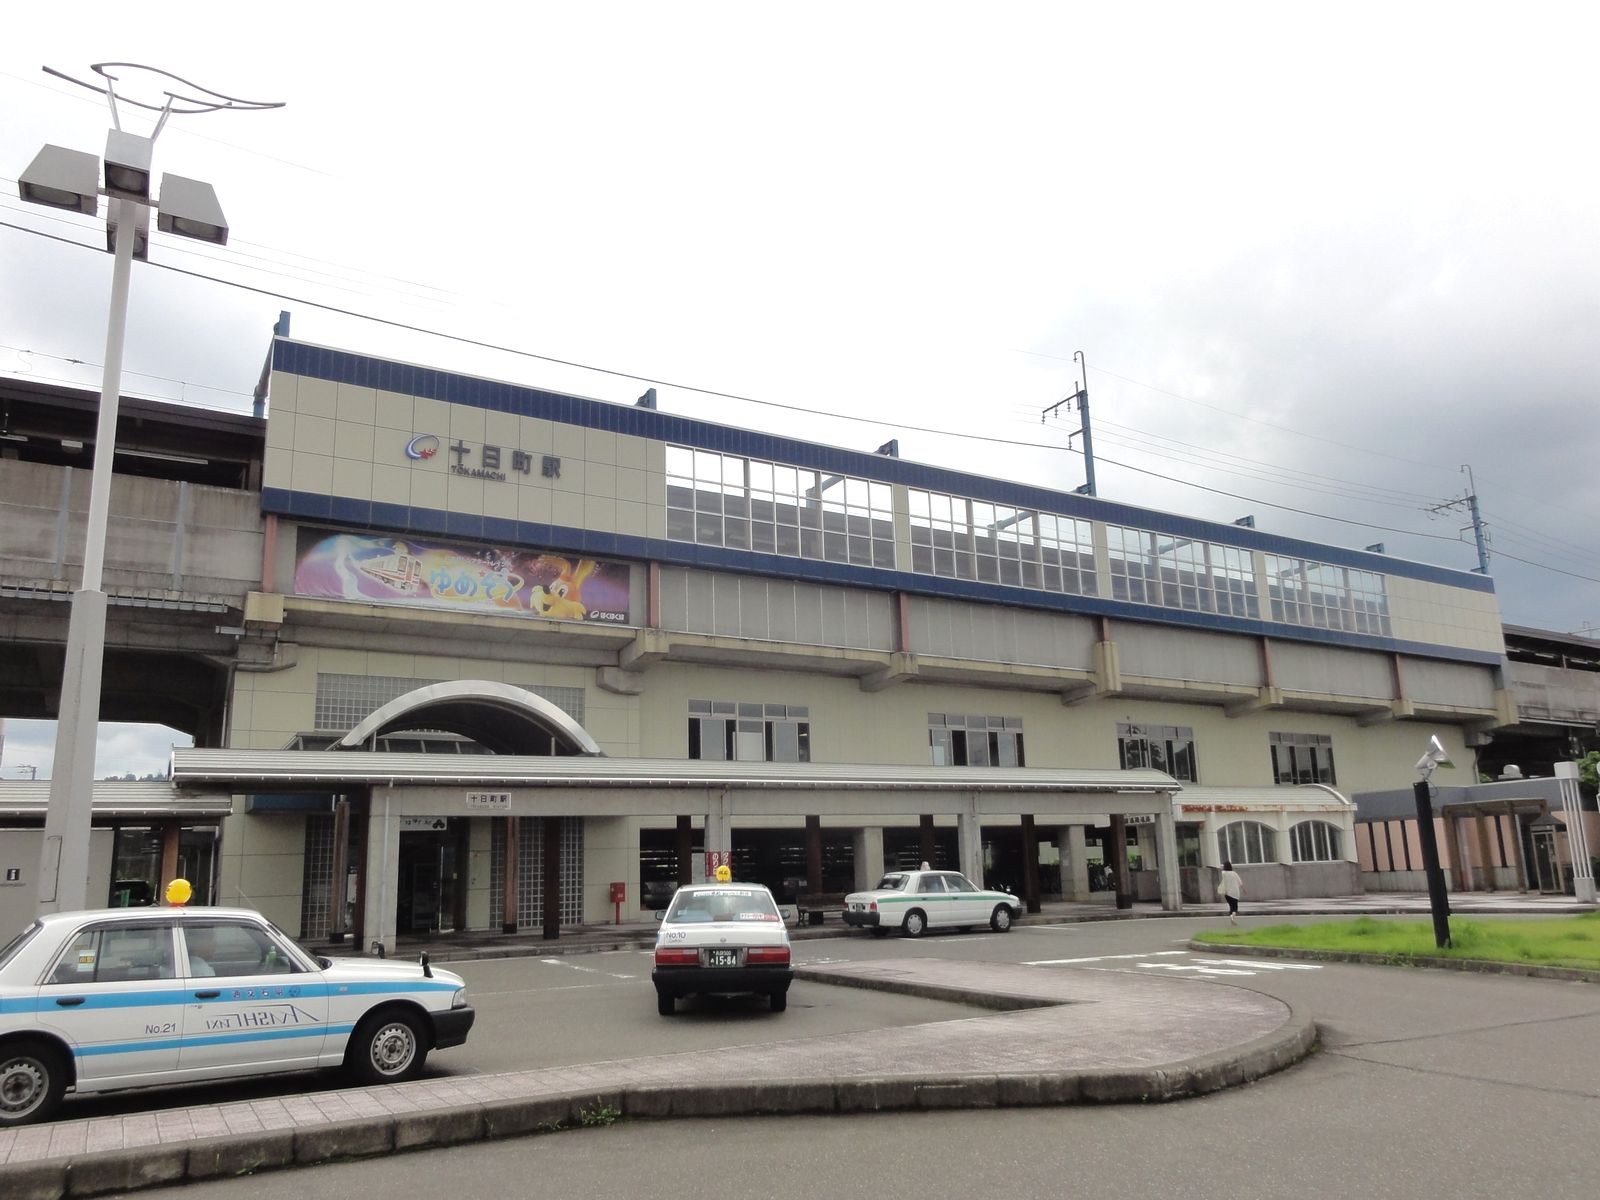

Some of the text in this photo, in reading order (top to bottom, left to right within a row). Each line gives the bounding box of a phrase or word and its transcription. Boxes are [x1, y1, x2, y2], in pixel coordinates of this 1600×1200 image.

[450, 439, 561, 479] 十日町駅
[471, 794, 507, 803] 十日町駅
[666, 931, 686, 939] No.10
[145, 1023, 176, 1034] No.21
